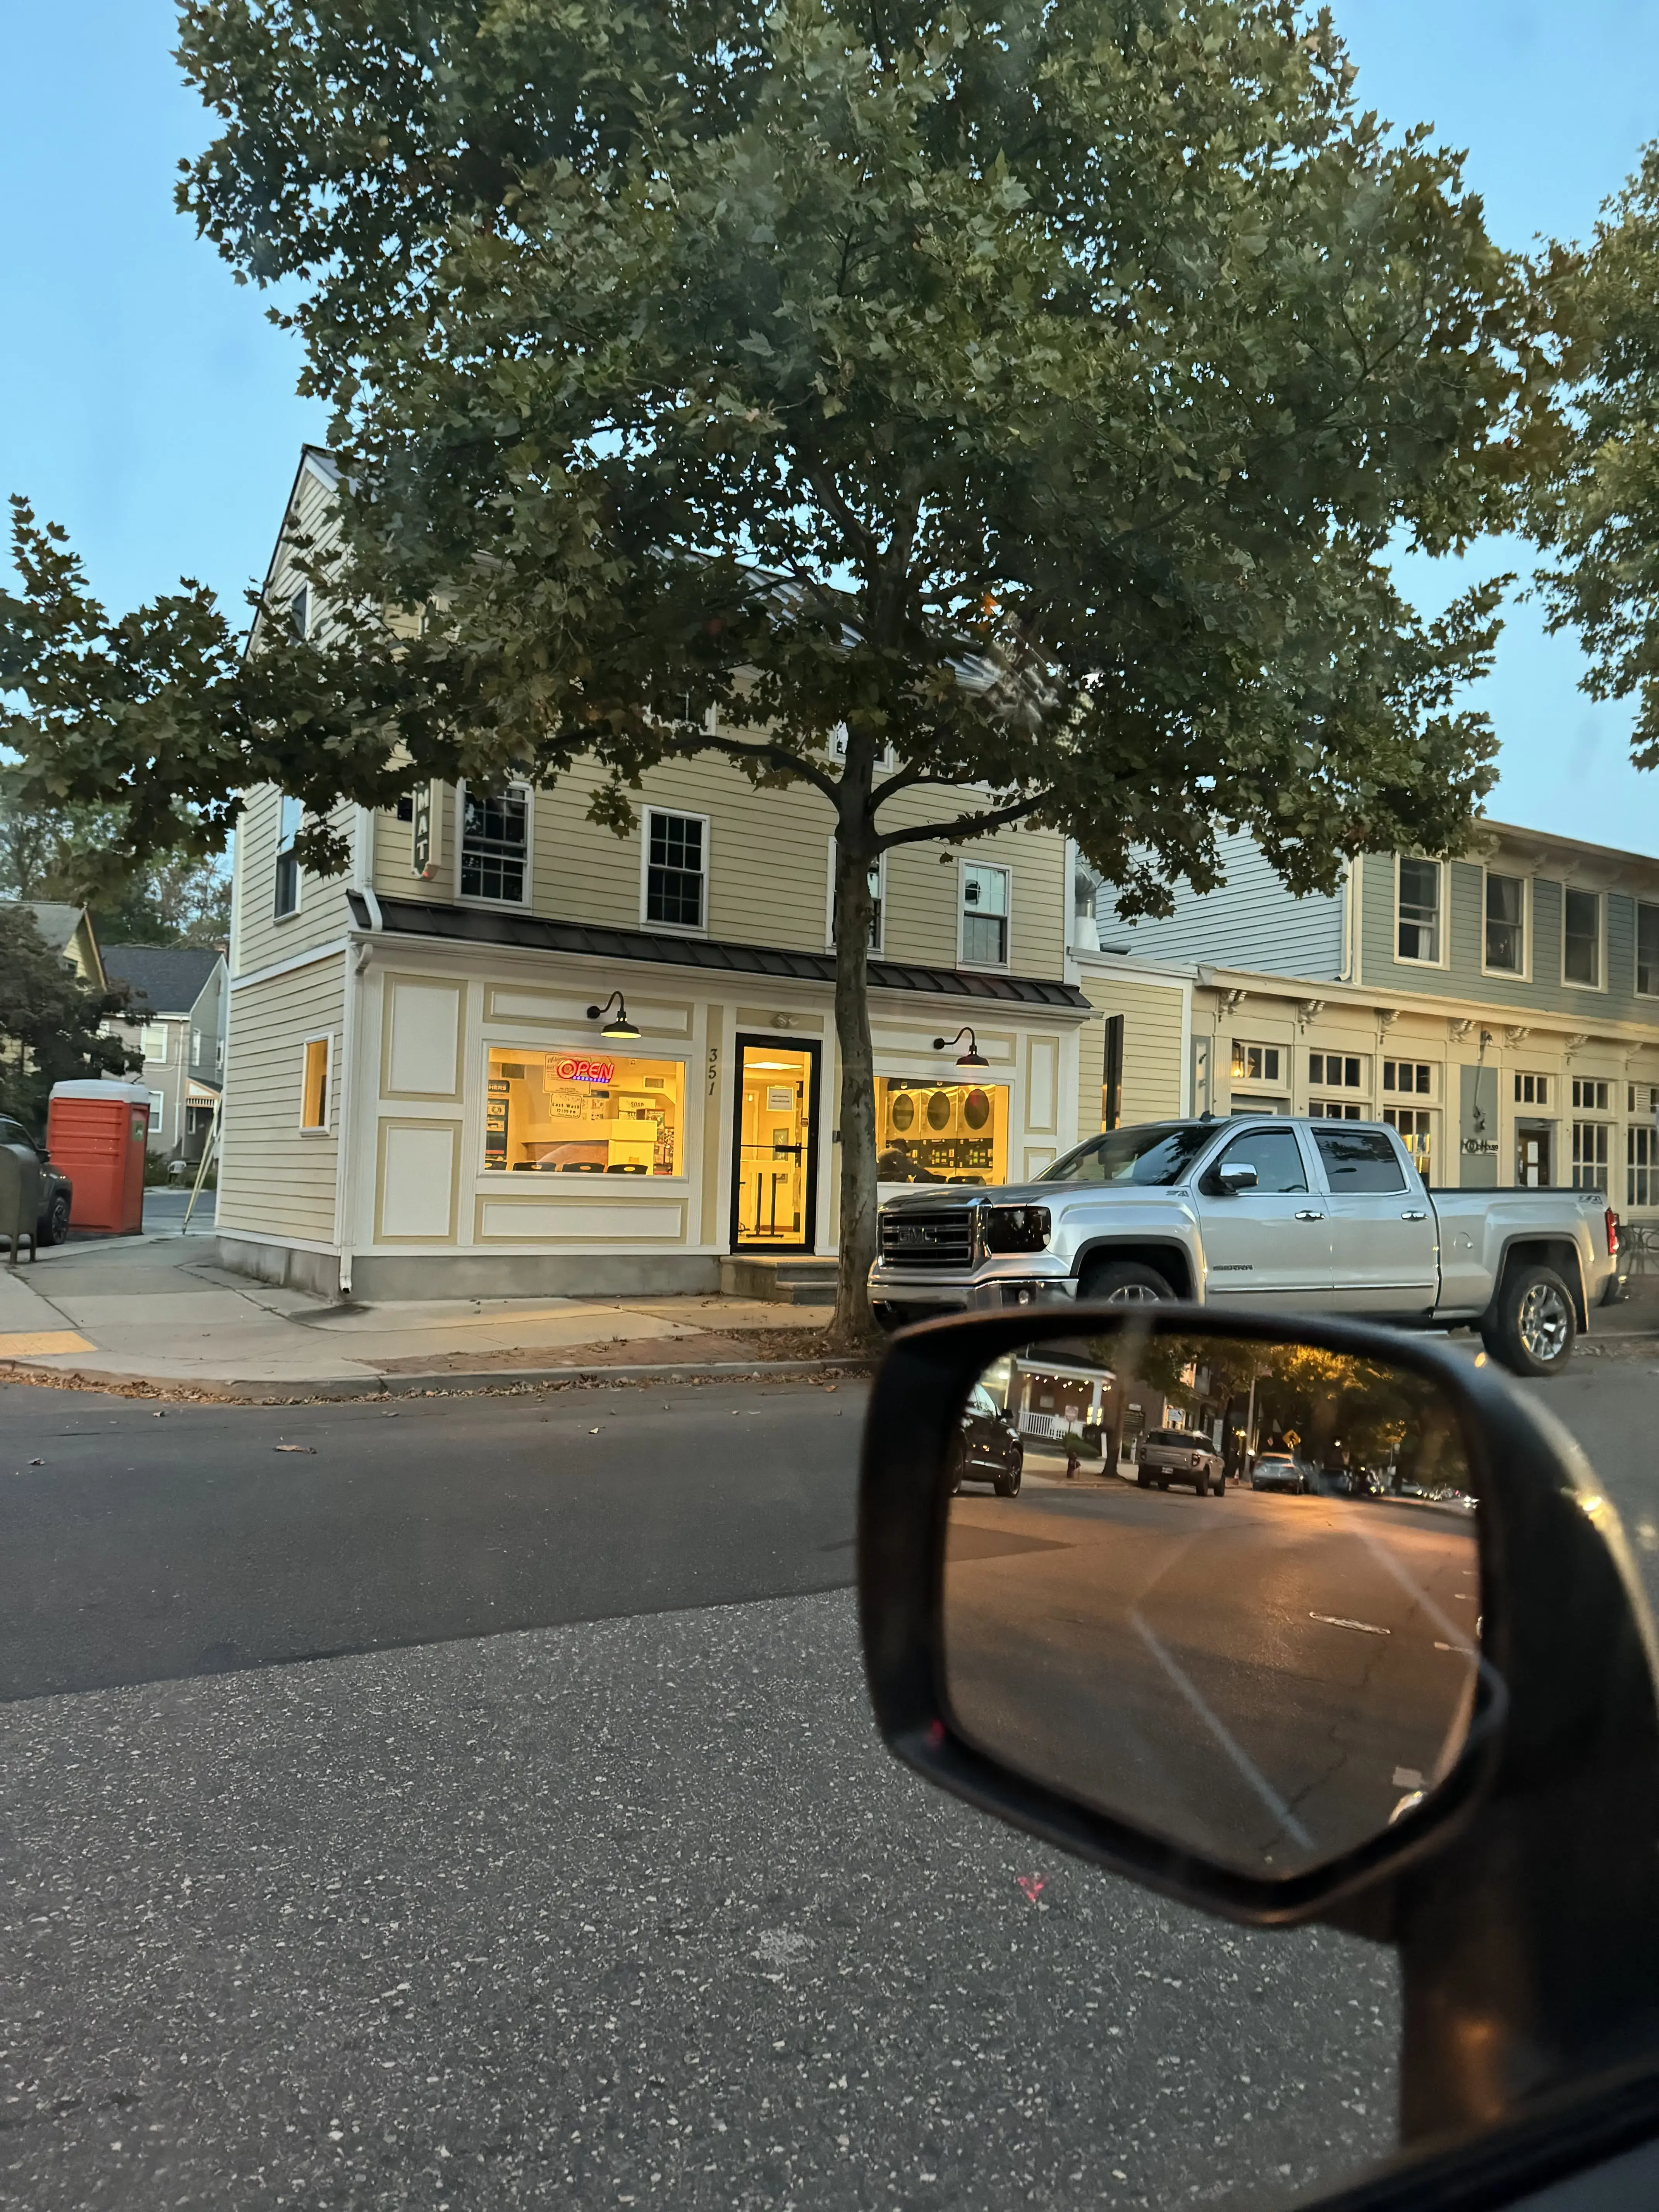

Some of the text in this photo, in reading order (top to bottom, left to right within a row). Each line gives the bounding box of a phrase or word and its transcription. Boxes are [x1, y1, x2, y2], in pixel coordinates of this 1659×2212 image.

[417, 787, 429, 860] MAT
[556, 1059, 615, 1080] OPEN
[708, 1048, 718, 1096] 351
[898, 1226, 938, 1244] GMC
